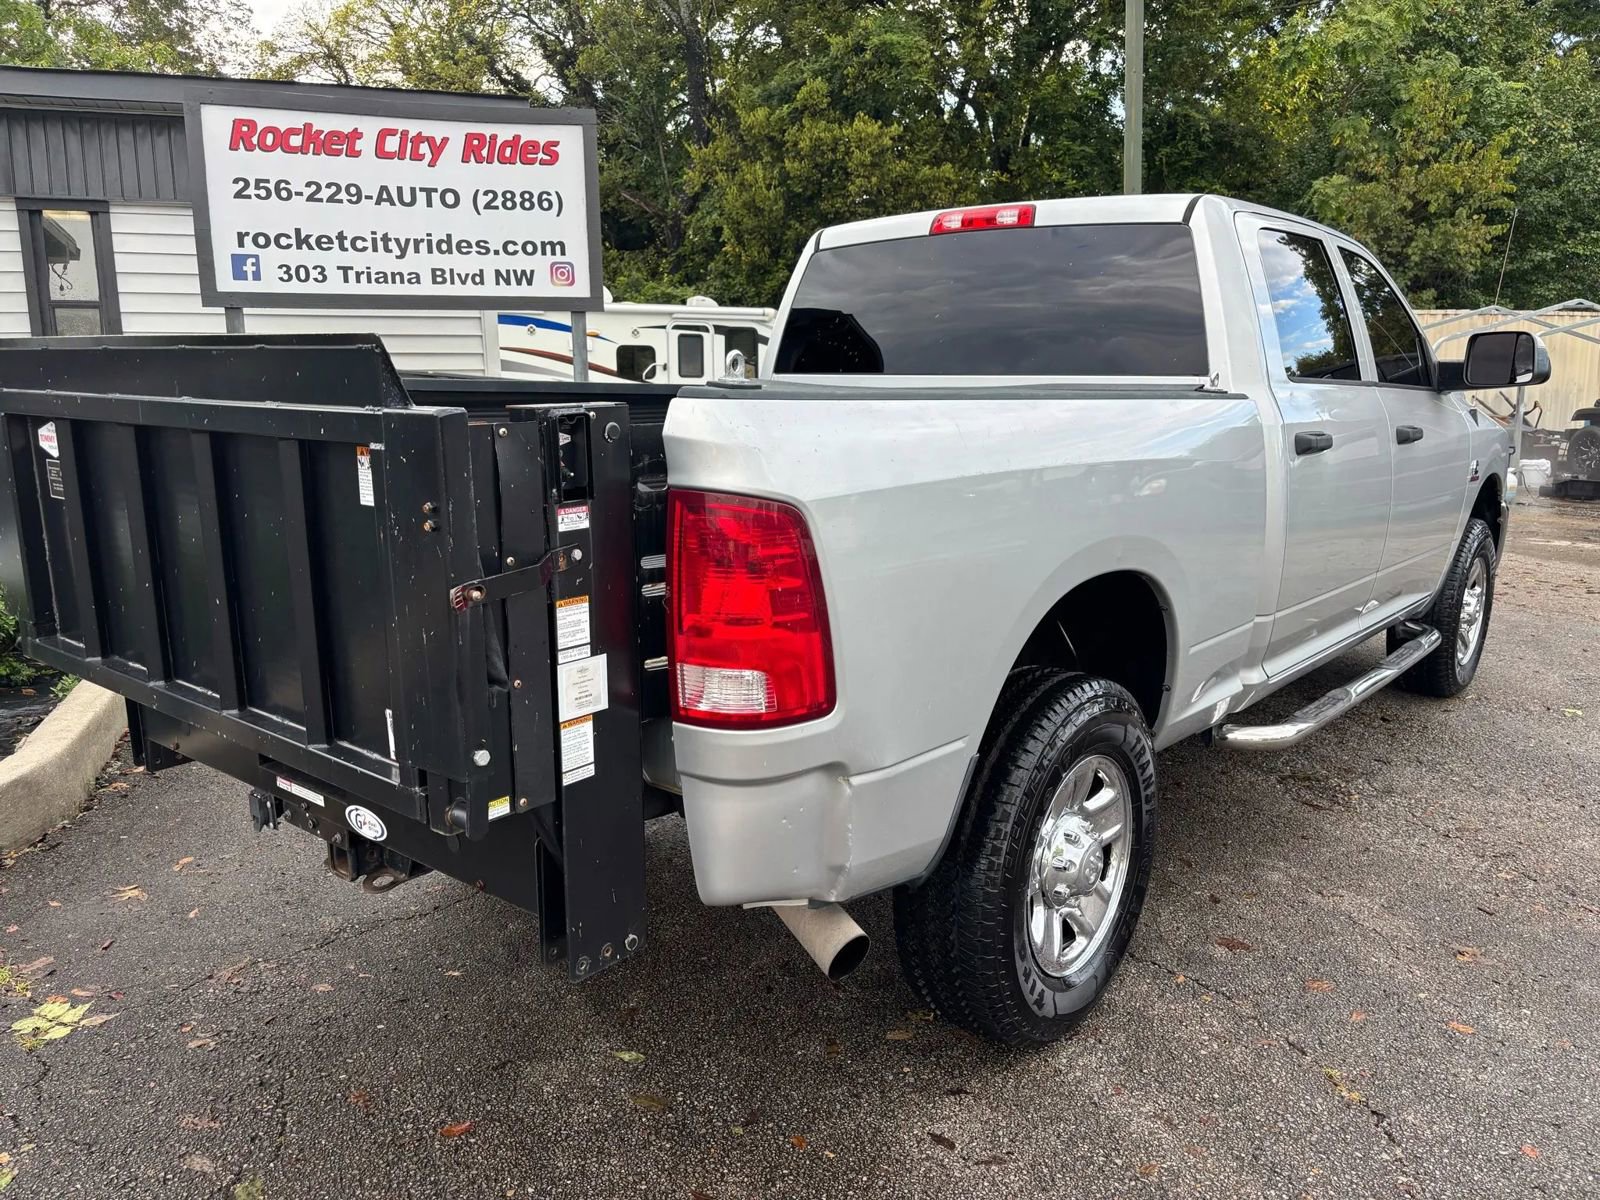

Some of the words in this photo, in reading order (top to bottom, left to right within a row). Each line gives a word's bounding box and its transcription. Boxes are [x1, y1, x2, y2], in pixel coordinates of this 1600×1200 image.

[229, 118, 363, 158] Rocket
[375, 127, 450, 168] City
[461, 132, 560, 166] Rides
[232, 176, 461, 209] 256-229-AUTO
[472, 189, 564, 217] (2886)
[236, 227, 567, 260] rocketcityrides.com
[277, 263, 328, 283] 303
[336, 265, 422, 285] Triana
[431, 267, 485, 286] Blvd
[495, 268, 536, 286] NW
